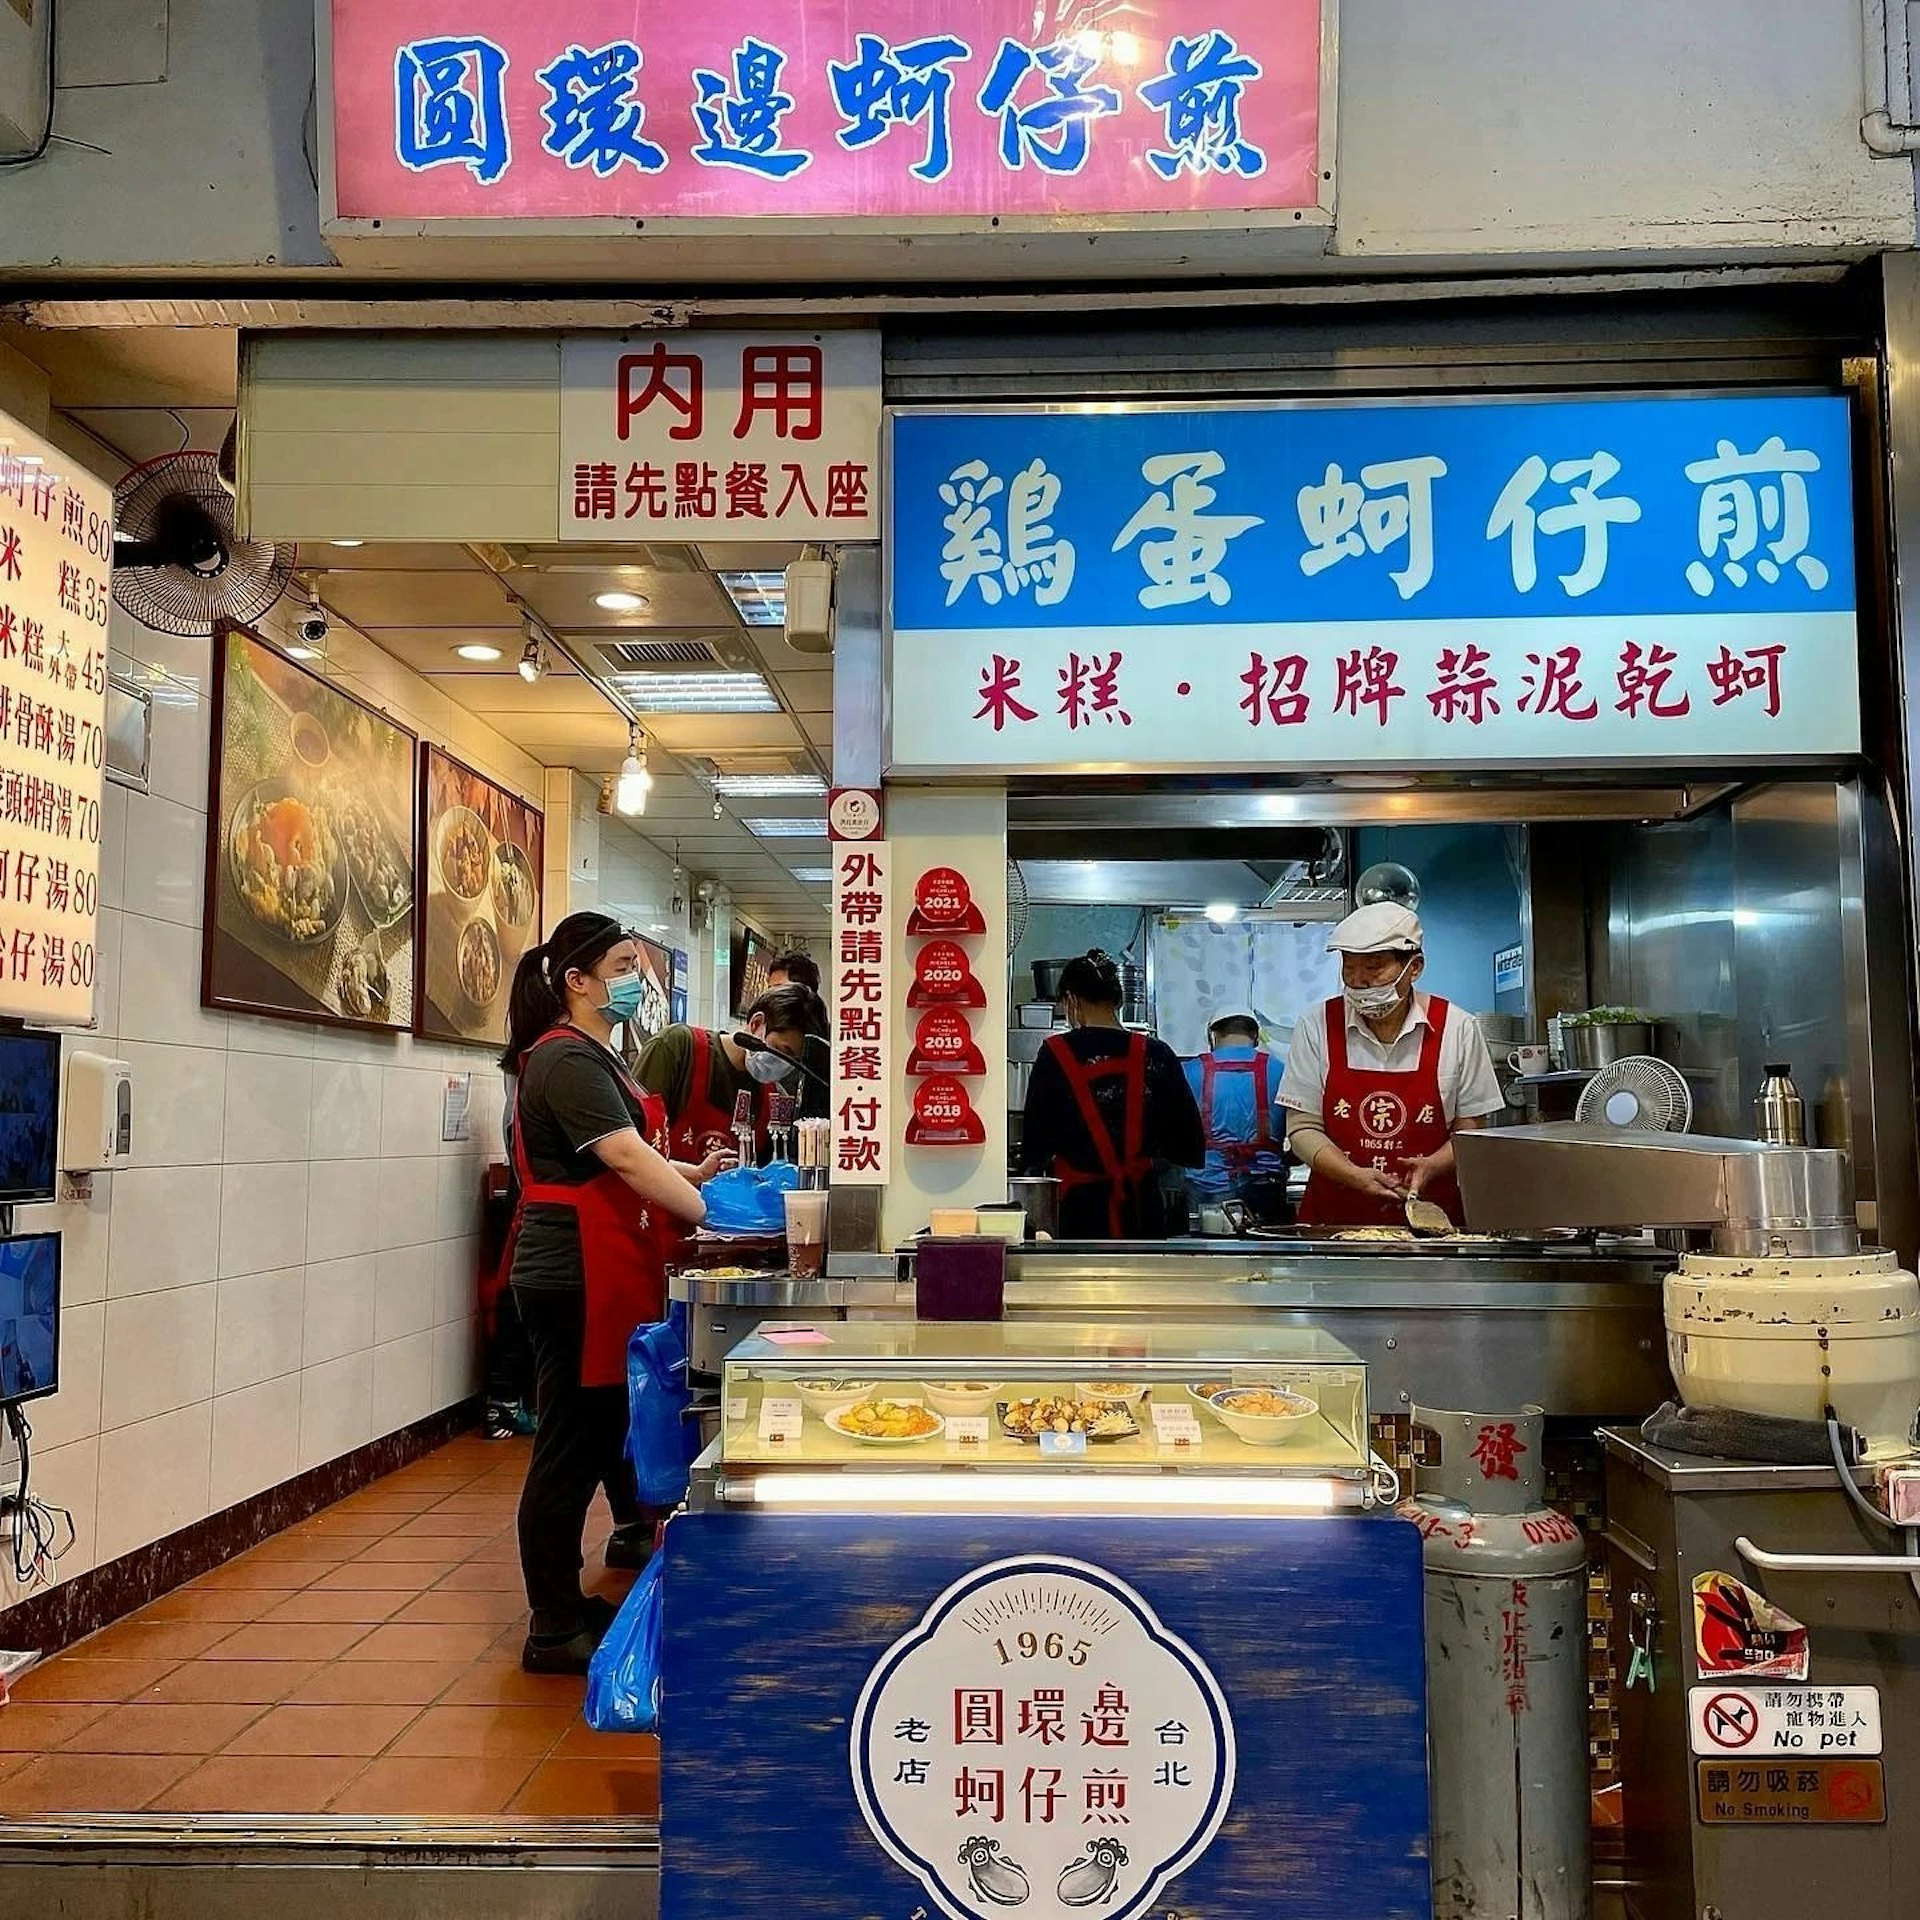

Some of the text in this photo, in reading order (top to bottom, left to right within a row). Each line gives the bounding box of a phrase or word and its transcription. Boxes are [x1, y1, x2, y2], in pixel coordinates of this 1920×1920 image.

[394, 31, 1268, 185] 圓環邊蚵仔煎
[573, 460, 869, 520] 請先點餐入座
[87, 511, 111, 562] 80
[84, 577, 108, 627] 35
[82, 647, 105, 695] 45
[81, 720, 103, 770] 70
[77, 795, 99, 844] 70
[74, 868, 97, 917] 80
[923, 896, 961, 909] 2021
[70, 940, 94, 988] 80
[923, 969, 963, 982] 2020
[924, 1036, 963, 1049] 2019
[922, 1104, 961, 1117] 2018
[1470, 1422, 1528, 1481] 發
[993, 1631, 1093, 1667] 1965
[953, 1681, 1131, 1747] 圓環邊
[893, 1717, 933, 1786] 老店
[1152, 1719, 1194, 1788] 台北
[1774, 1730, 1857, 1749] No pet
[953, 1766, 1132, 1825] 蚵仔煎
[1715, 1802, 1809, 1818] No Smoking
